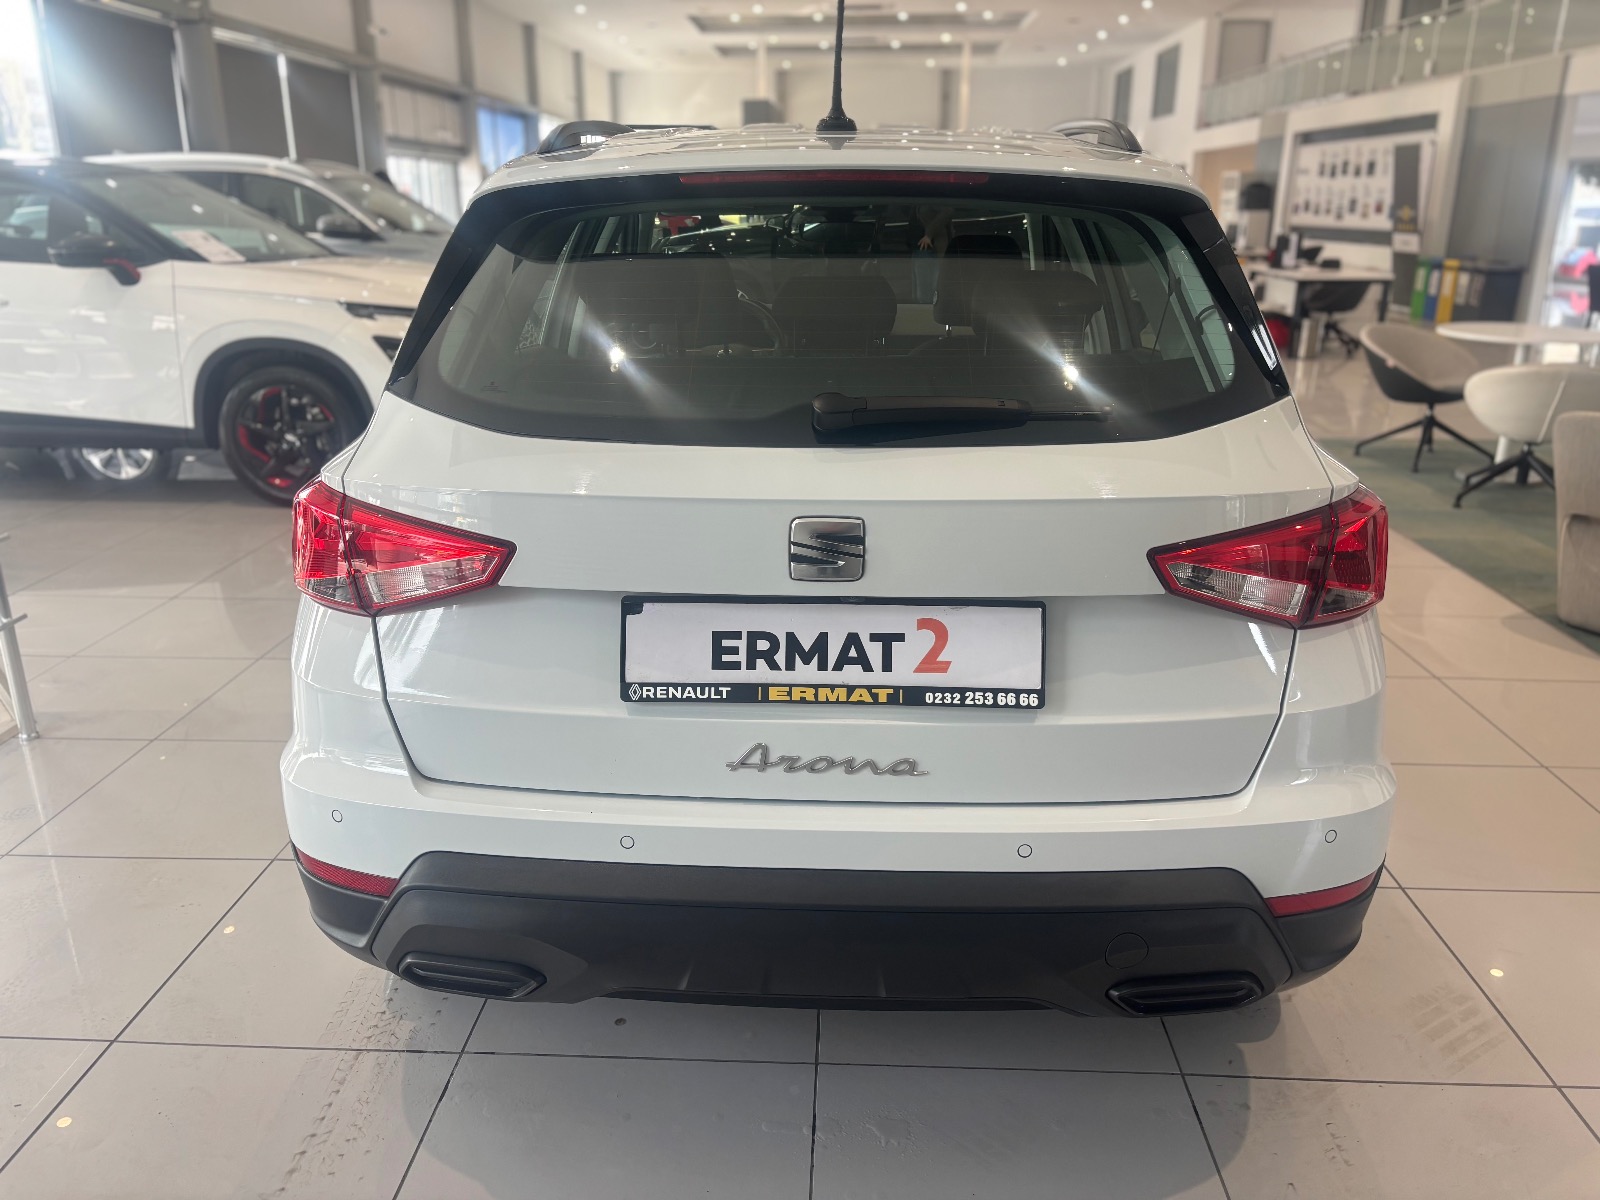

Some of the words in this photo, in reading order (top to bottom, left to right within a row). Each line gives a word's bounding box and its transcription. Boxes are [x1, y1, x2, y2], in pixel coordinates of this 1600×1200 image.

[711, 630, 906, 673] ERMAT
[912, 617, 953, 674] 2
[642, 686, 732, 699] RENAULT
[768, 686, 894, 703] ERMAT
[925, 692, 961, 704] 0232
[964, 691, 994, 706] 253
[997, 692, 1016, 706] 66
[1019, 693, 1039, 707] 66
[725, 742, 929, 776] Arona
